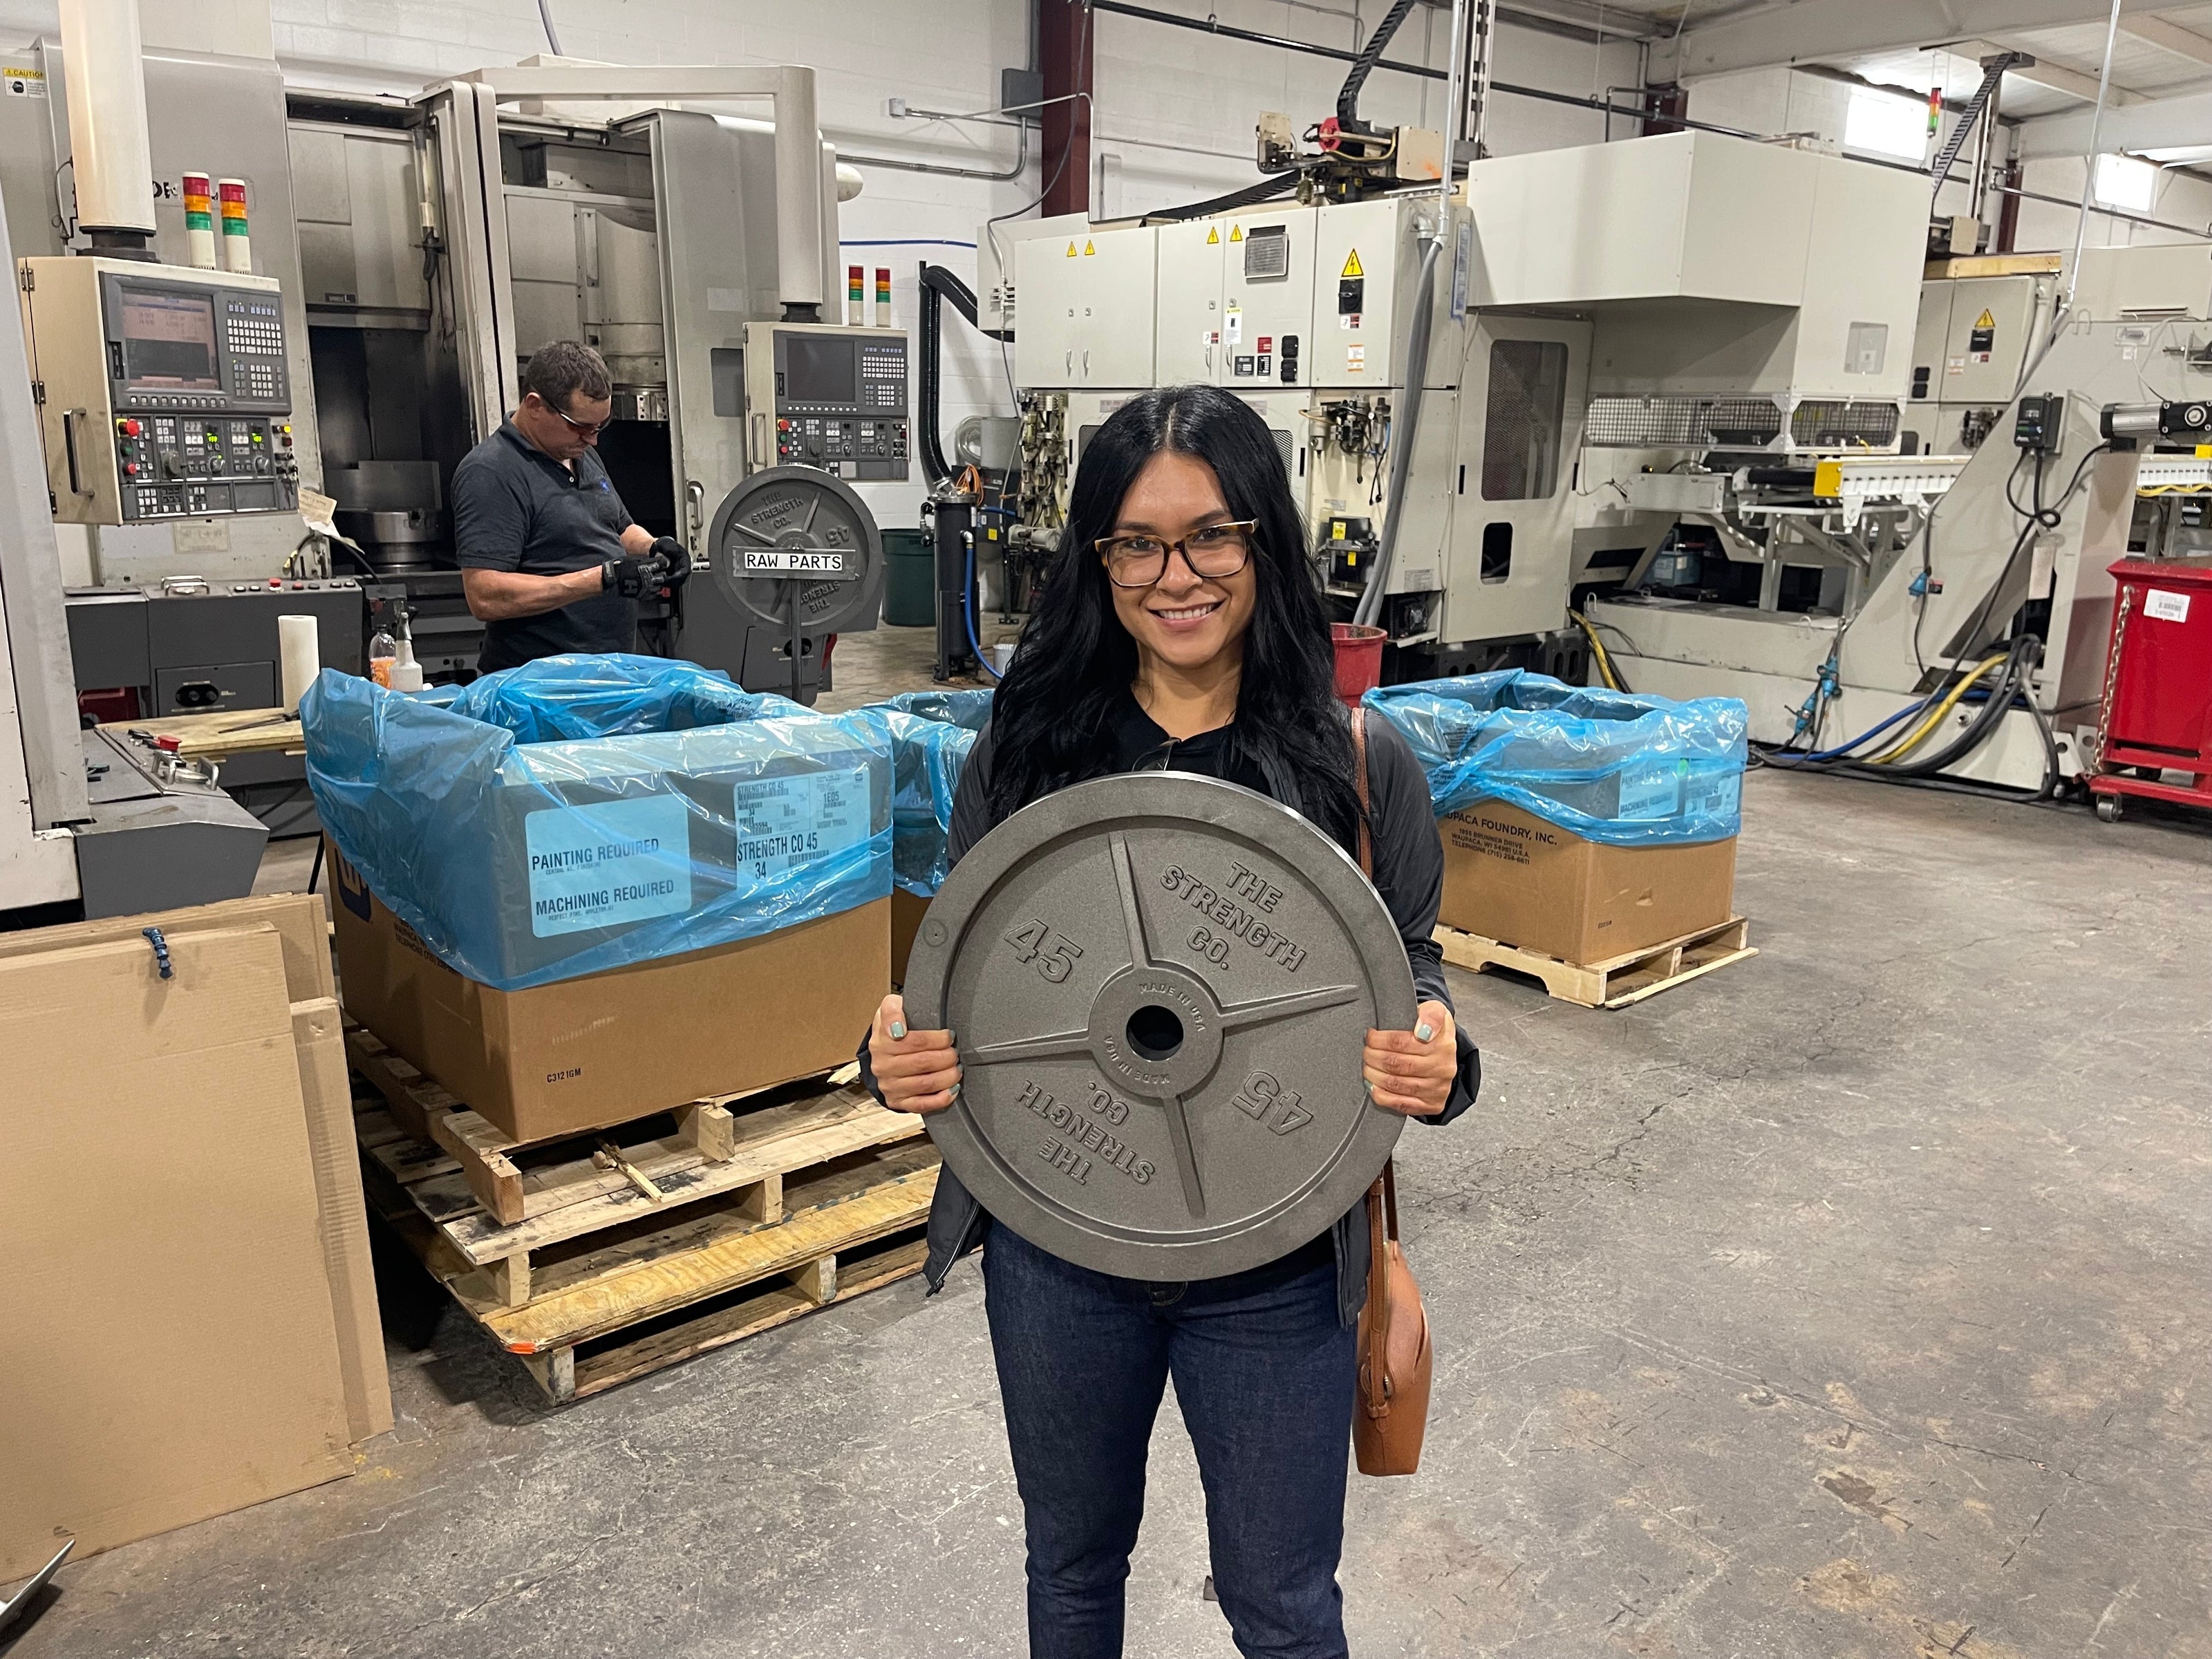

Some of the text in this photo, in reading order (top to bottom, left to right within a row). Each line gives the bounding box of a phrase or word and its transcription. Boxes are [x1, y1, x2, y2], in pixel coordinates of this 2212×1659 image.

[751, 496, 804, 525] STRENGTH
[761, 491, 782, 507] THE
[825, 525, 851, 546] 45
[747, 554, 841, 570] RAW PARTS
[801, 581, 841, 604] STRENG
[738, 780, 784, 794] STRENGTH CO 45
[1444, 811, 1557, 845] UPACA FOUNDRY, INC.
[532, 838, 659, 871] PAINTING REQUIRED
[738, 832, 818, 862] STRENGTH CO 45
[1452, 841, 1486, 855] TELEPHONE
[1487, 848, 1502, 859] (715)
[1503, 838, 1524, 850] DRIVE
[755, 861, 767, 880] 34
[536, 880, 674, 916] MACHINING REQUIRED
[1226, 861, 1283, 914] THE
[1160, 865, 1307, 973] STRENGTH
[1004, 918, 1083, 984] 45
[1187, 926, 1229, 971] CO.
[1139, 982, 1206, 1032] MADE IN USA
[547, 1067, 581, 1083] C3121GM
[1133, 1069, 1170, 1085] MADE
[1087, 1082, 1130, 1126] CO.
[1232, 1070, 1314, 1136] 45
[1014, 1080, 1156, 1185] STRENGTH
[1038, 1136, 1092, 1186] THE
